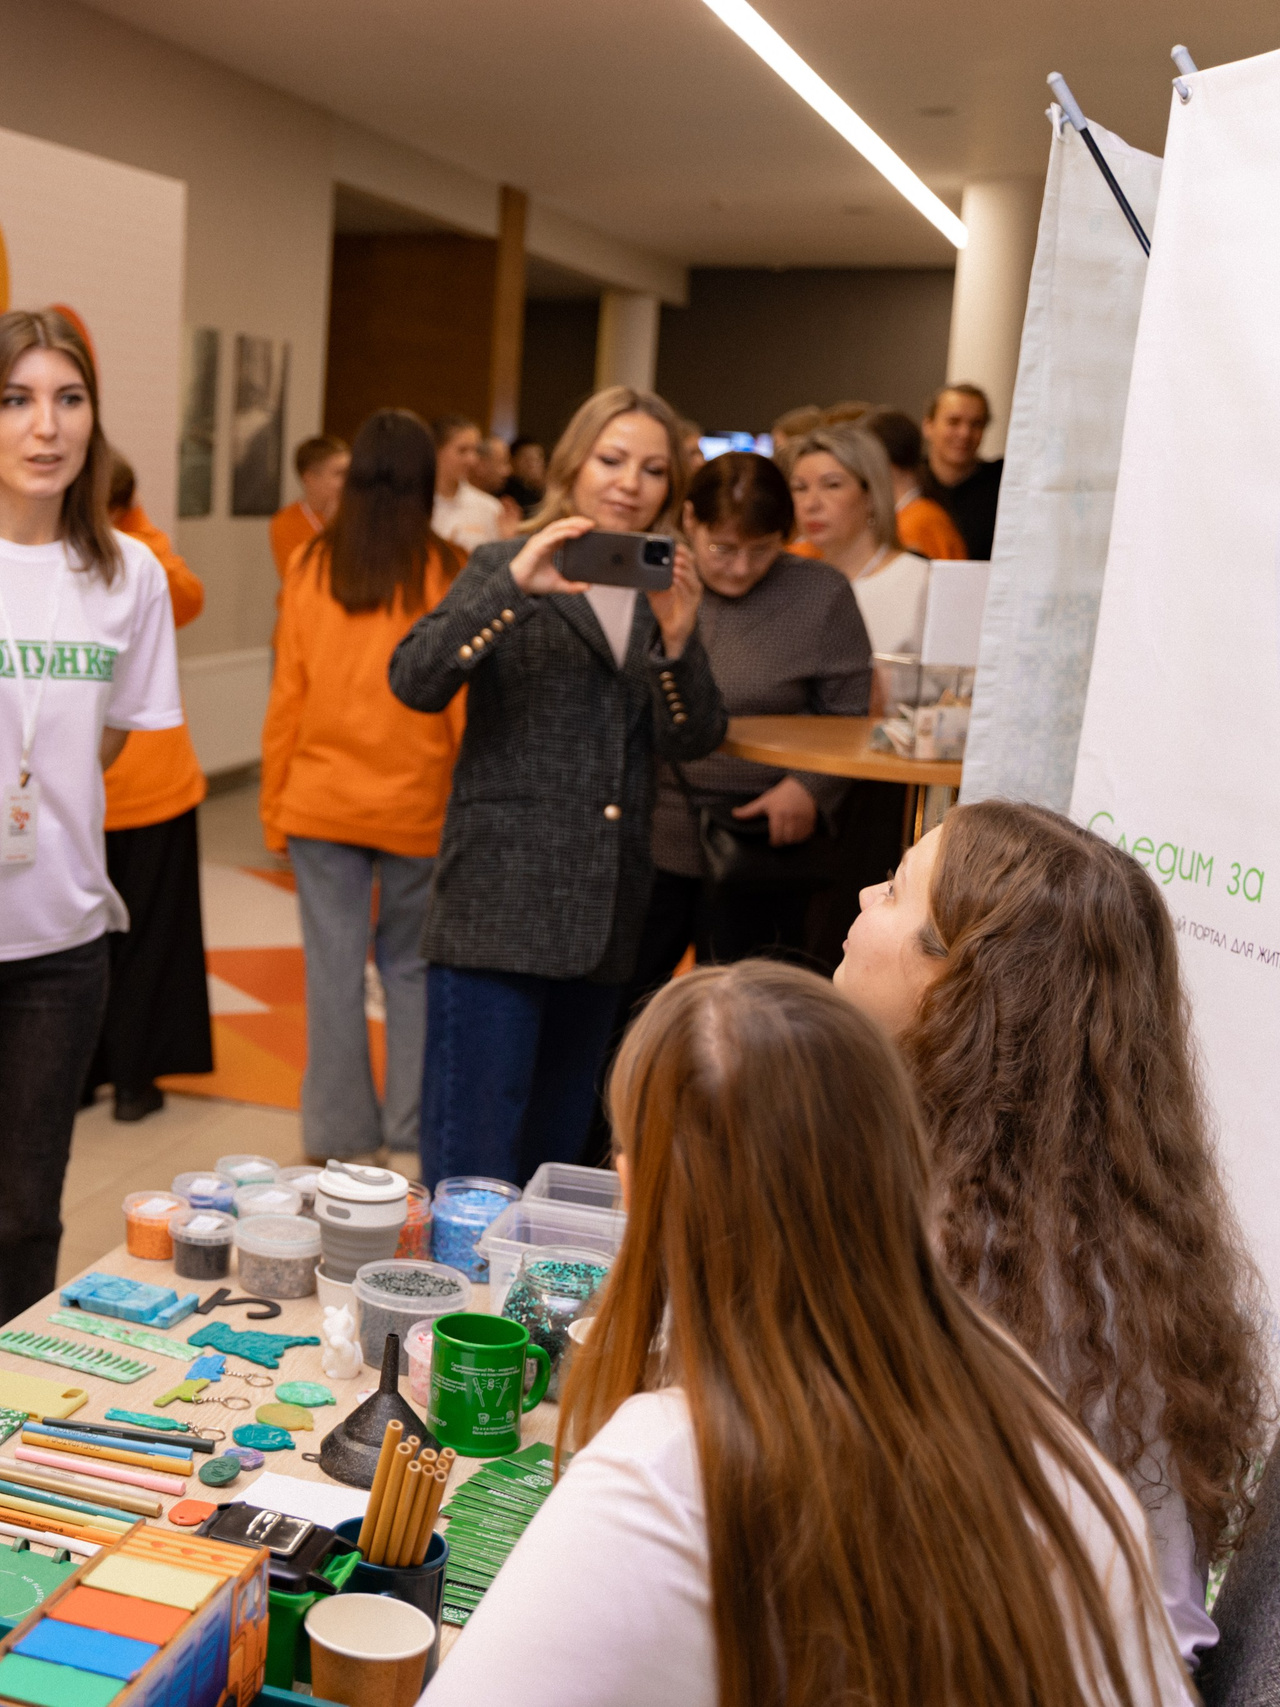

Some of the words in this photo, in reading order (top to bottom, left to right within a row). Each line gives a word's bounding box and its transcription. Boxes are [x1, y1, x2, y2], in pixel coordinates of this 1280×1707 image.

[1226, 862, 1265, 903] за
[1188, 921, 1227, 950] ПОРТАЛ
[1230, 938, 1255, 959] ДЛЯ
